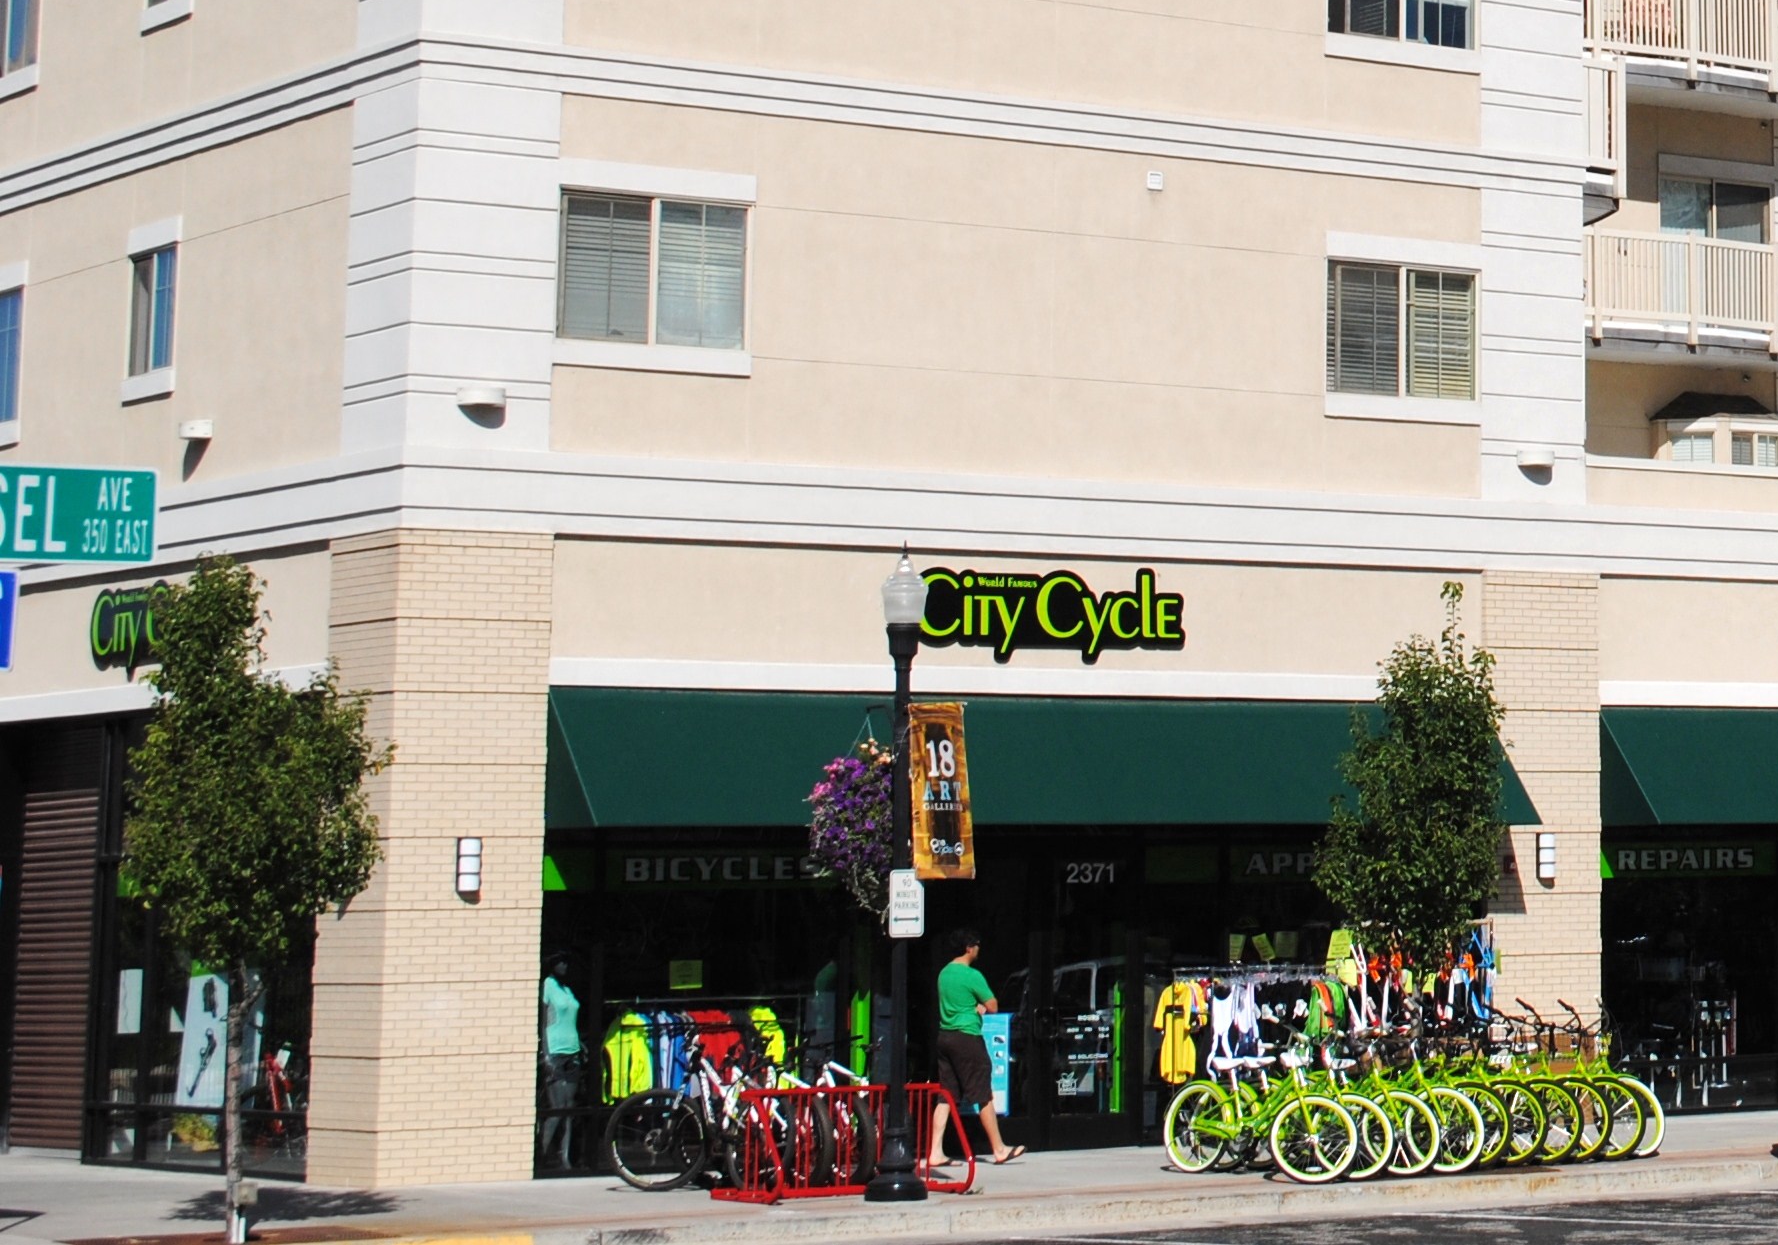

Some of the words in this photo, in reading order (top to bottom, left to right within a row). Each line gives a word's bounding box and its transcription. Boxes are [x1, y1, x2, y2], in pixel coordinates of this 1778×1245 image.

[97, 477, 132, 512] AVE
[82, 518, 108, 553] 350
[115, 519, 148, 555] EAST
[926, 739, 956, 778] 18
[923, 781, 962, 802] ART
[1066, 862, 1114, 883] 2371
[1617, 848, 1753, 871] REPAIRS
